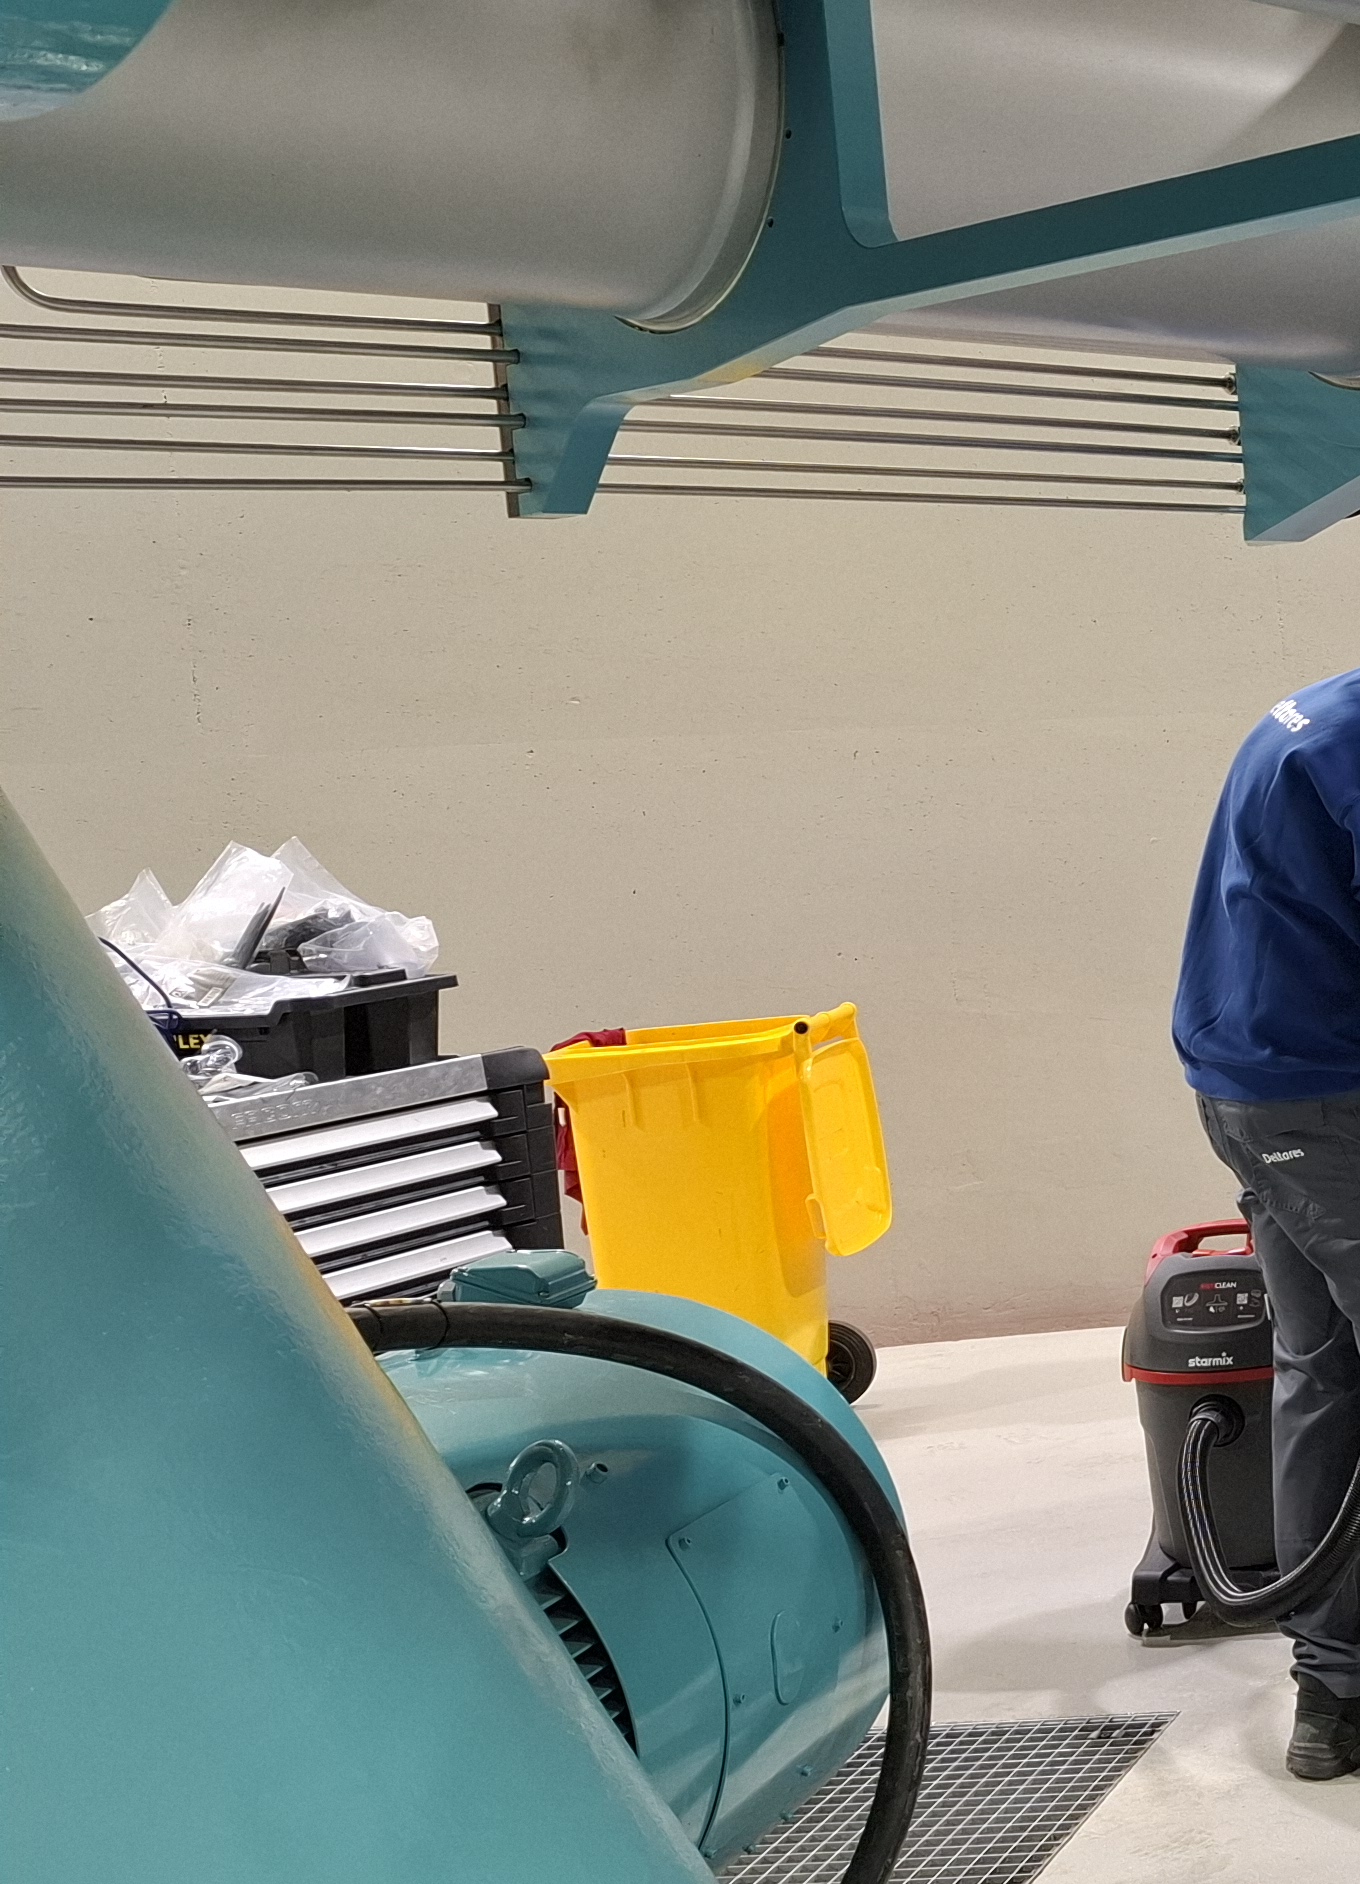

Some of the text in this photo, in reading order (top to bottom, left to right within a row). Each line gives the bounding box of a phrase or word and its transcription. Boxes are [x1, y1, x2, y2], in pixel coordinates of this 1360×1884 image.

[1270, 699, 1311, 732] eltares
[1261, 1149, 1305, 1164] Deltares
[1188, 1351, 1234, 1367] starmix
